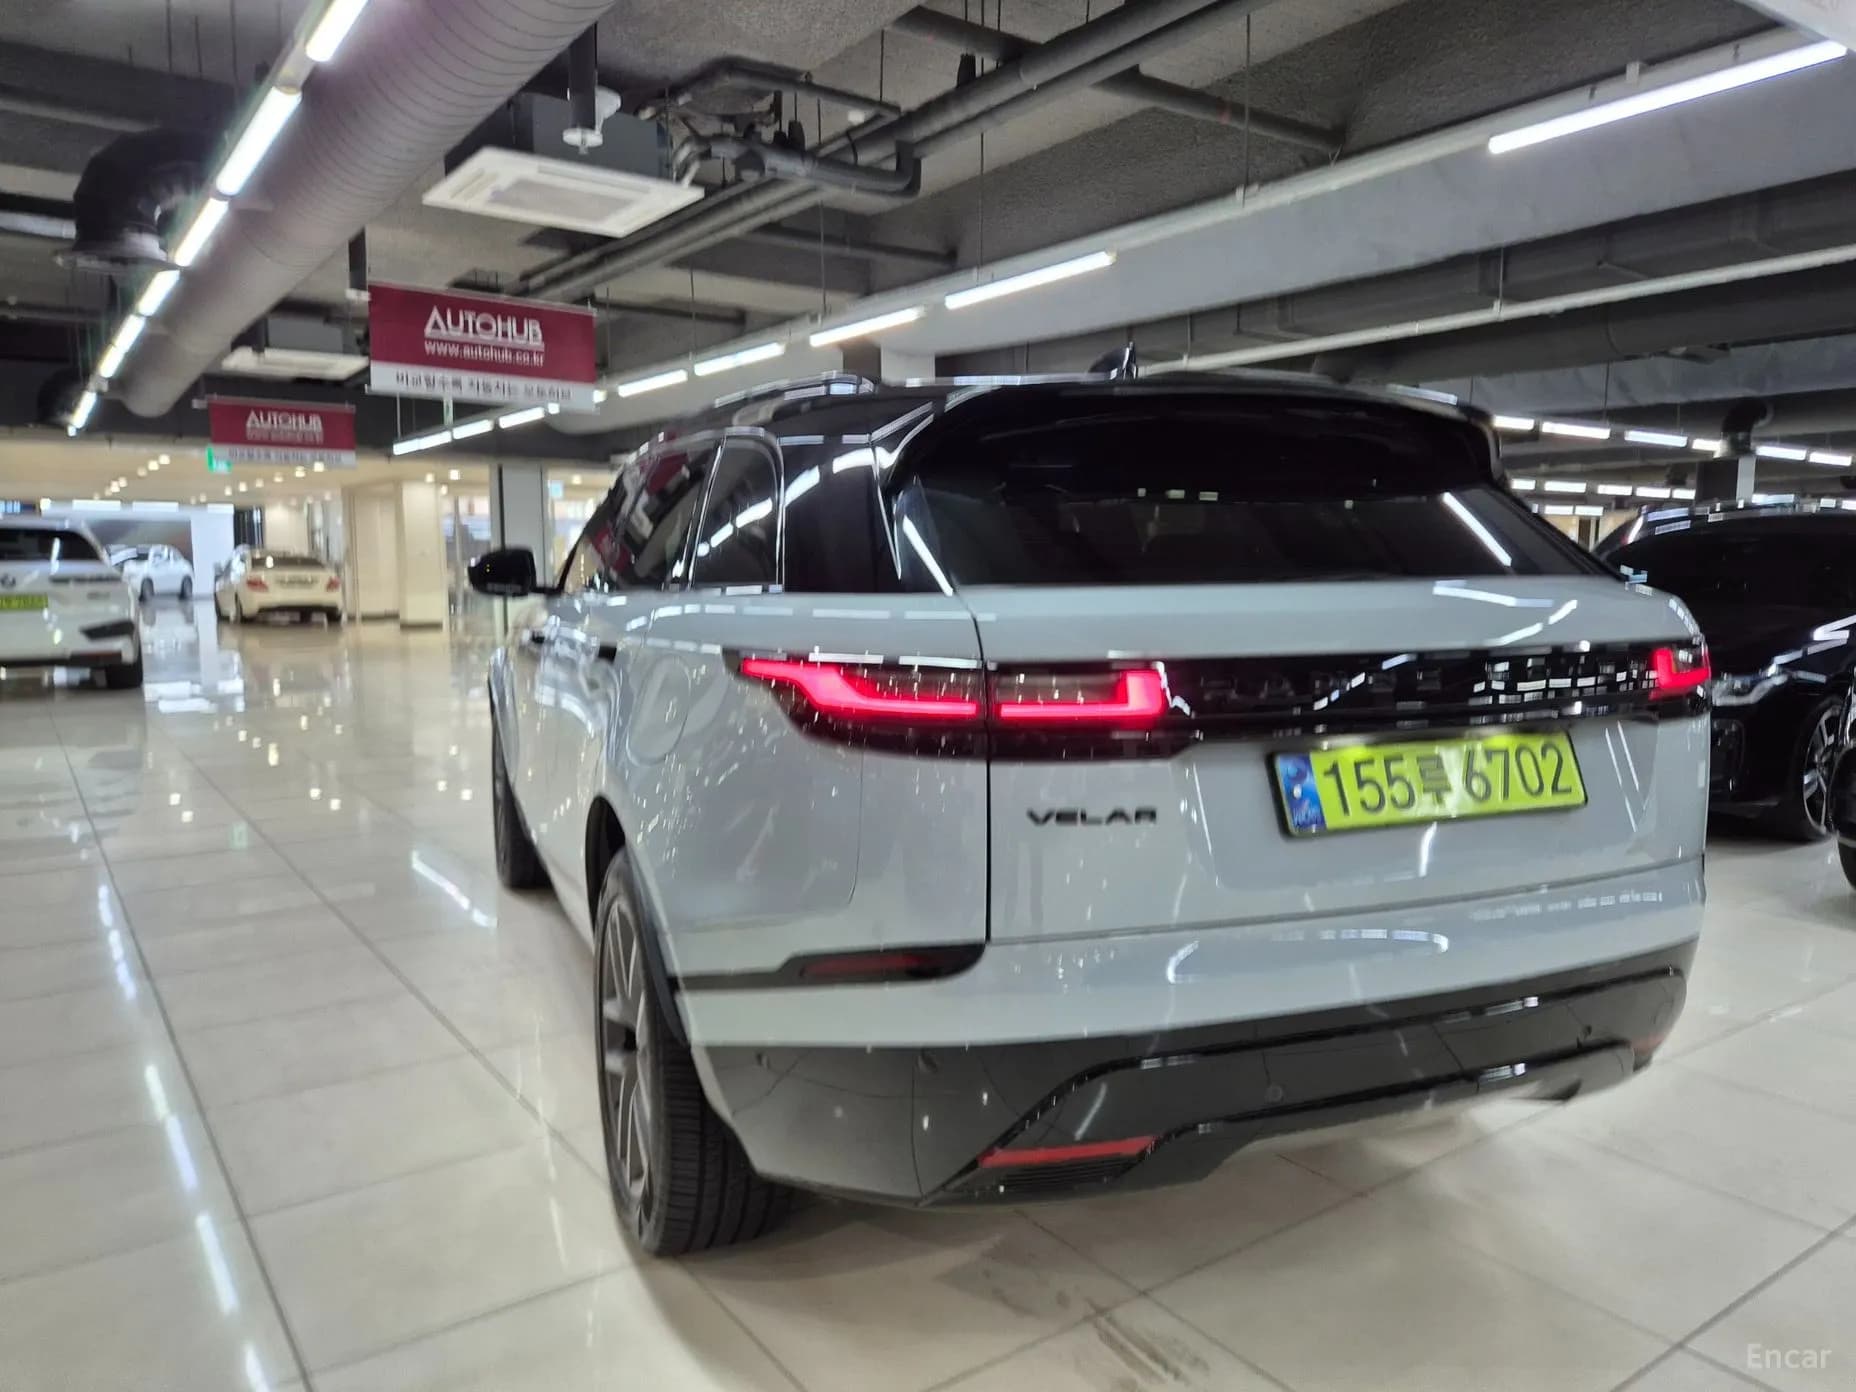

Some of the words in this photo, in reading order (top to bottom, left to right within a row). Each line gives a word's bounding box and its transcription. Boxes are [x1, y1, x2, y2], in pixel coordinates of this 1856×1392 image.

[424, 305, 544, 347] AUTOHUB
[424, 340, 544, 367] www.autohub.co.kr
[246, 410, 323, 433] AUTOHUB
[1464, 743, 1572, 801] 6702
[1027, 809, 1157, 825] VELAR
